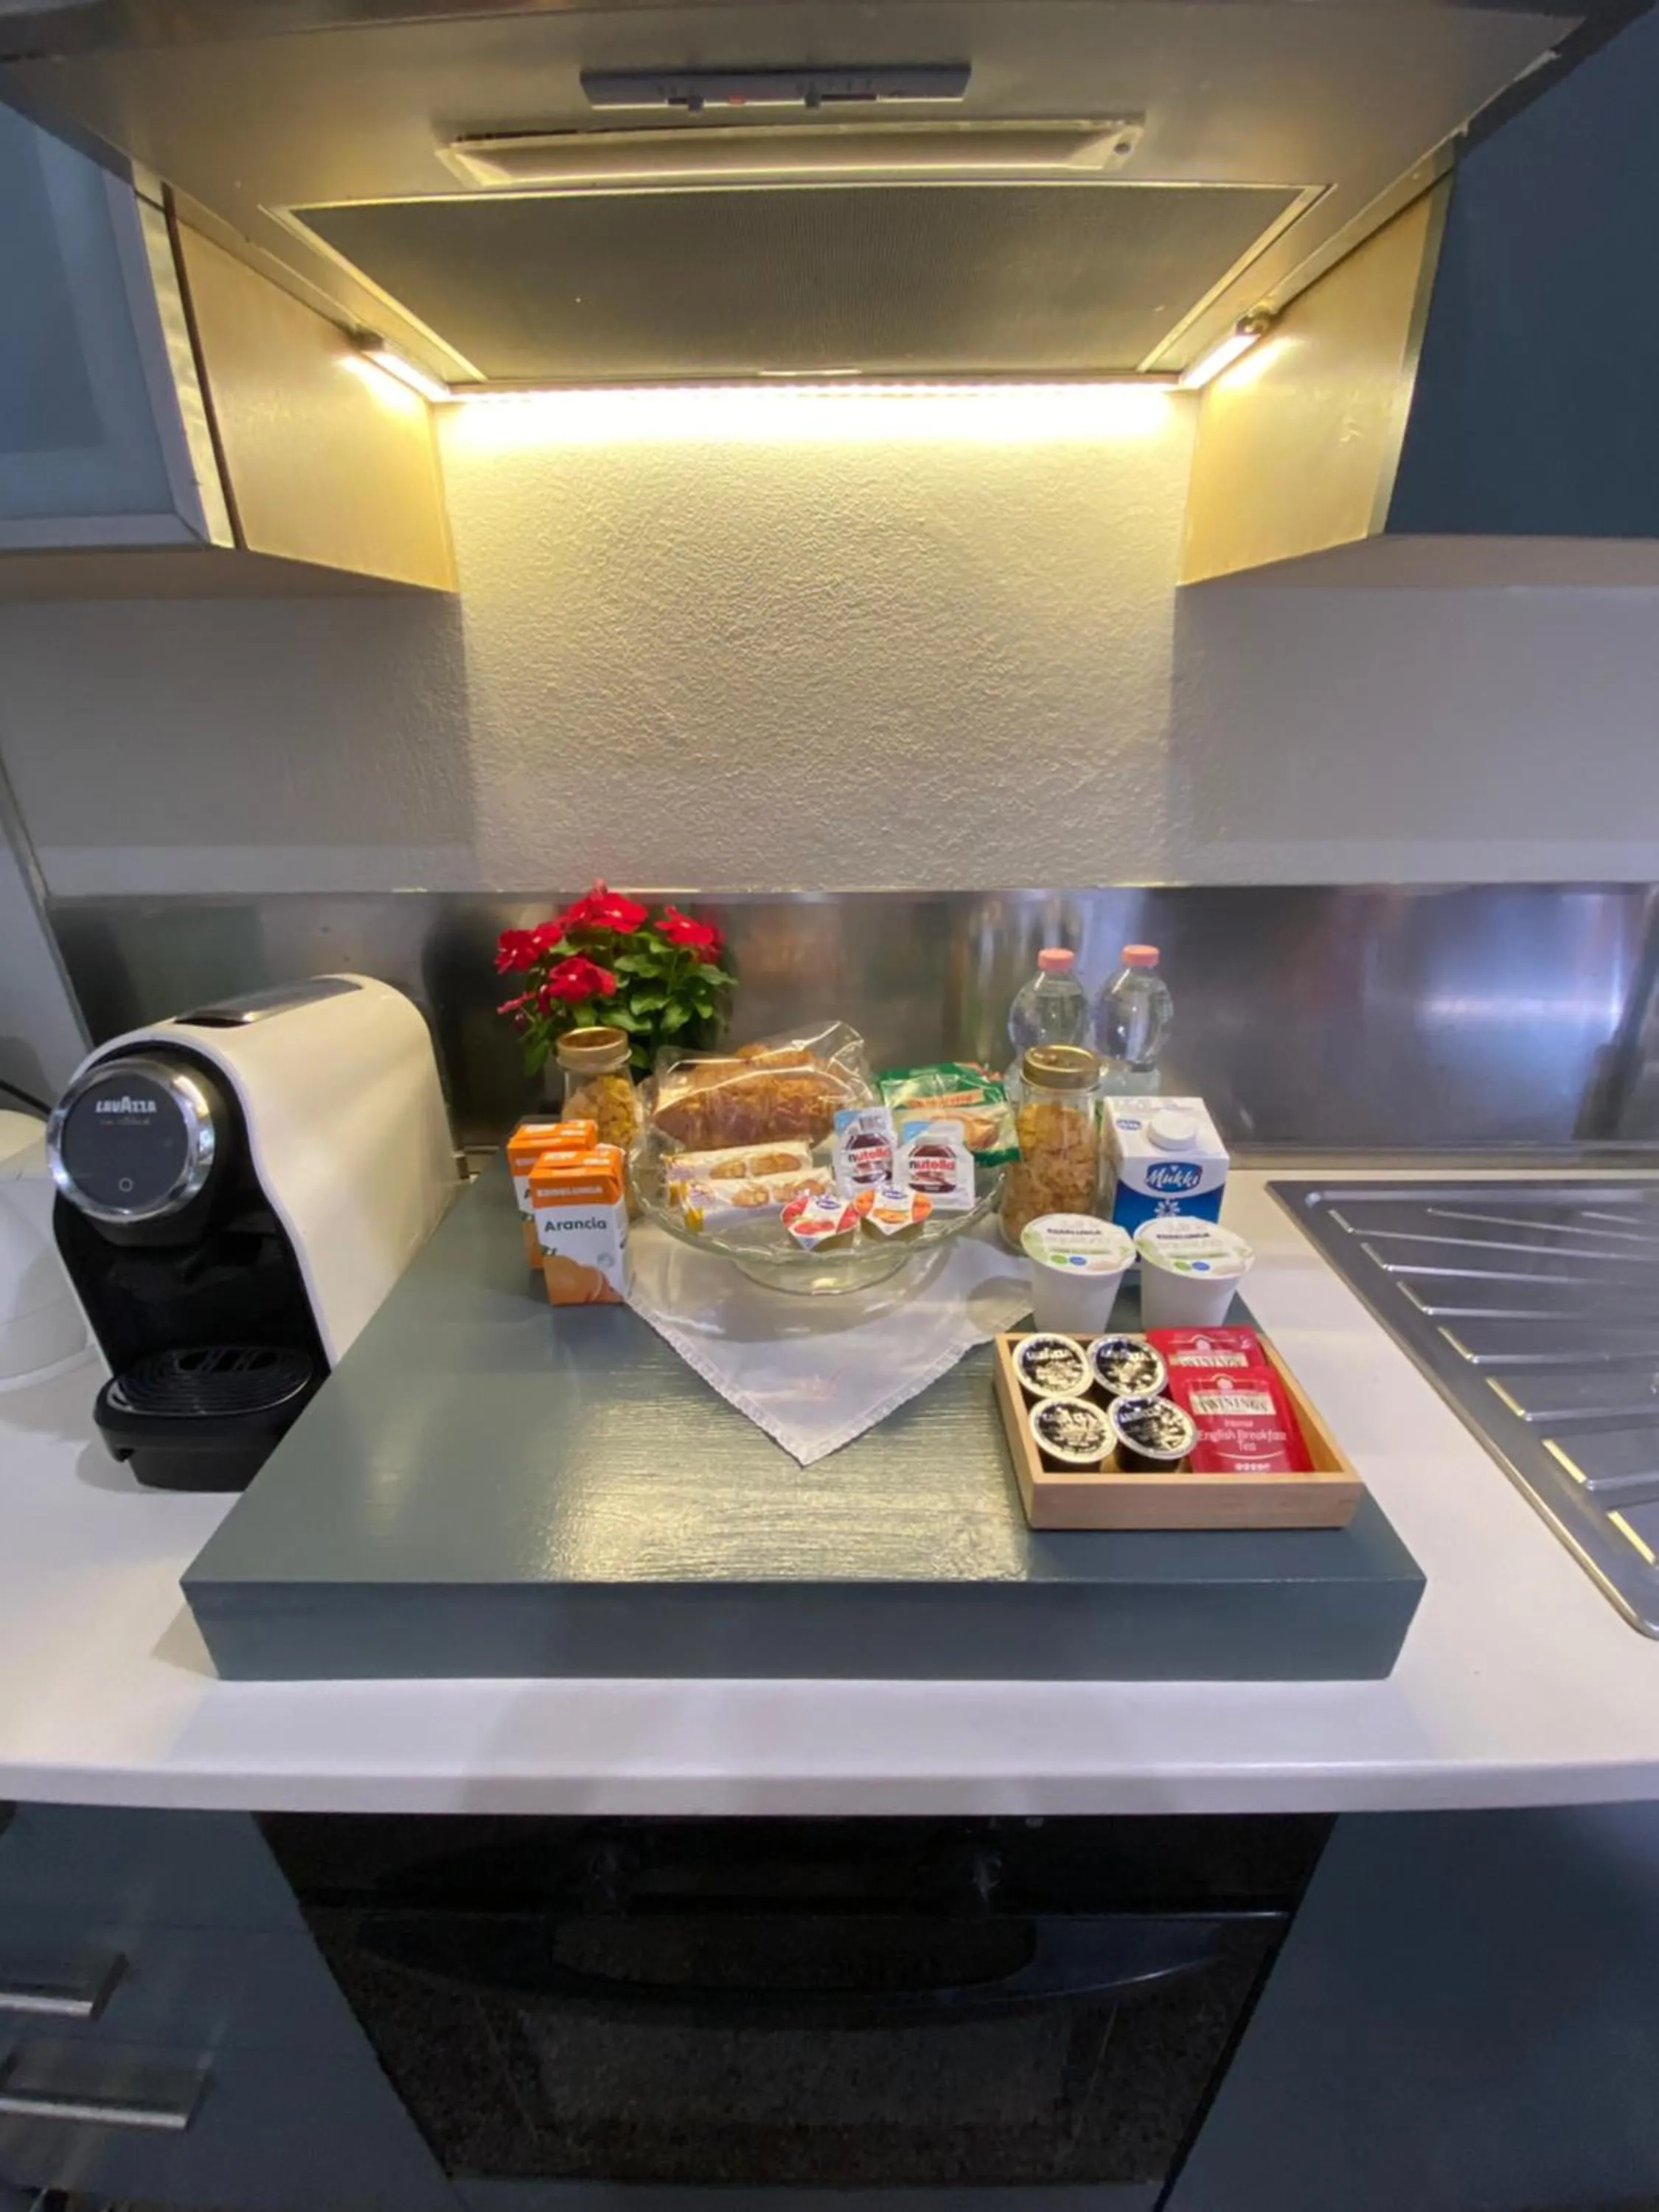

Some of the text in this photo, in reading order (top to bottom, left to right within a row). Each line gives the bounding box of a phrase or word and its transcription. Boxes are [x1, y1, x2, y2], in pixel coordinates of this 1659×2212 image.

[95, 1096, 157, 1113] LAVAZZA
[849, 1147, 891, 1162] nutella
[909, 1160, 955, 1170] nutella
[1145, 1168, 1199, 1189] Mukki
[544, 1217, 607, 1232] Arancia
[1197, 1397, 1269, 1412] TWININGS
